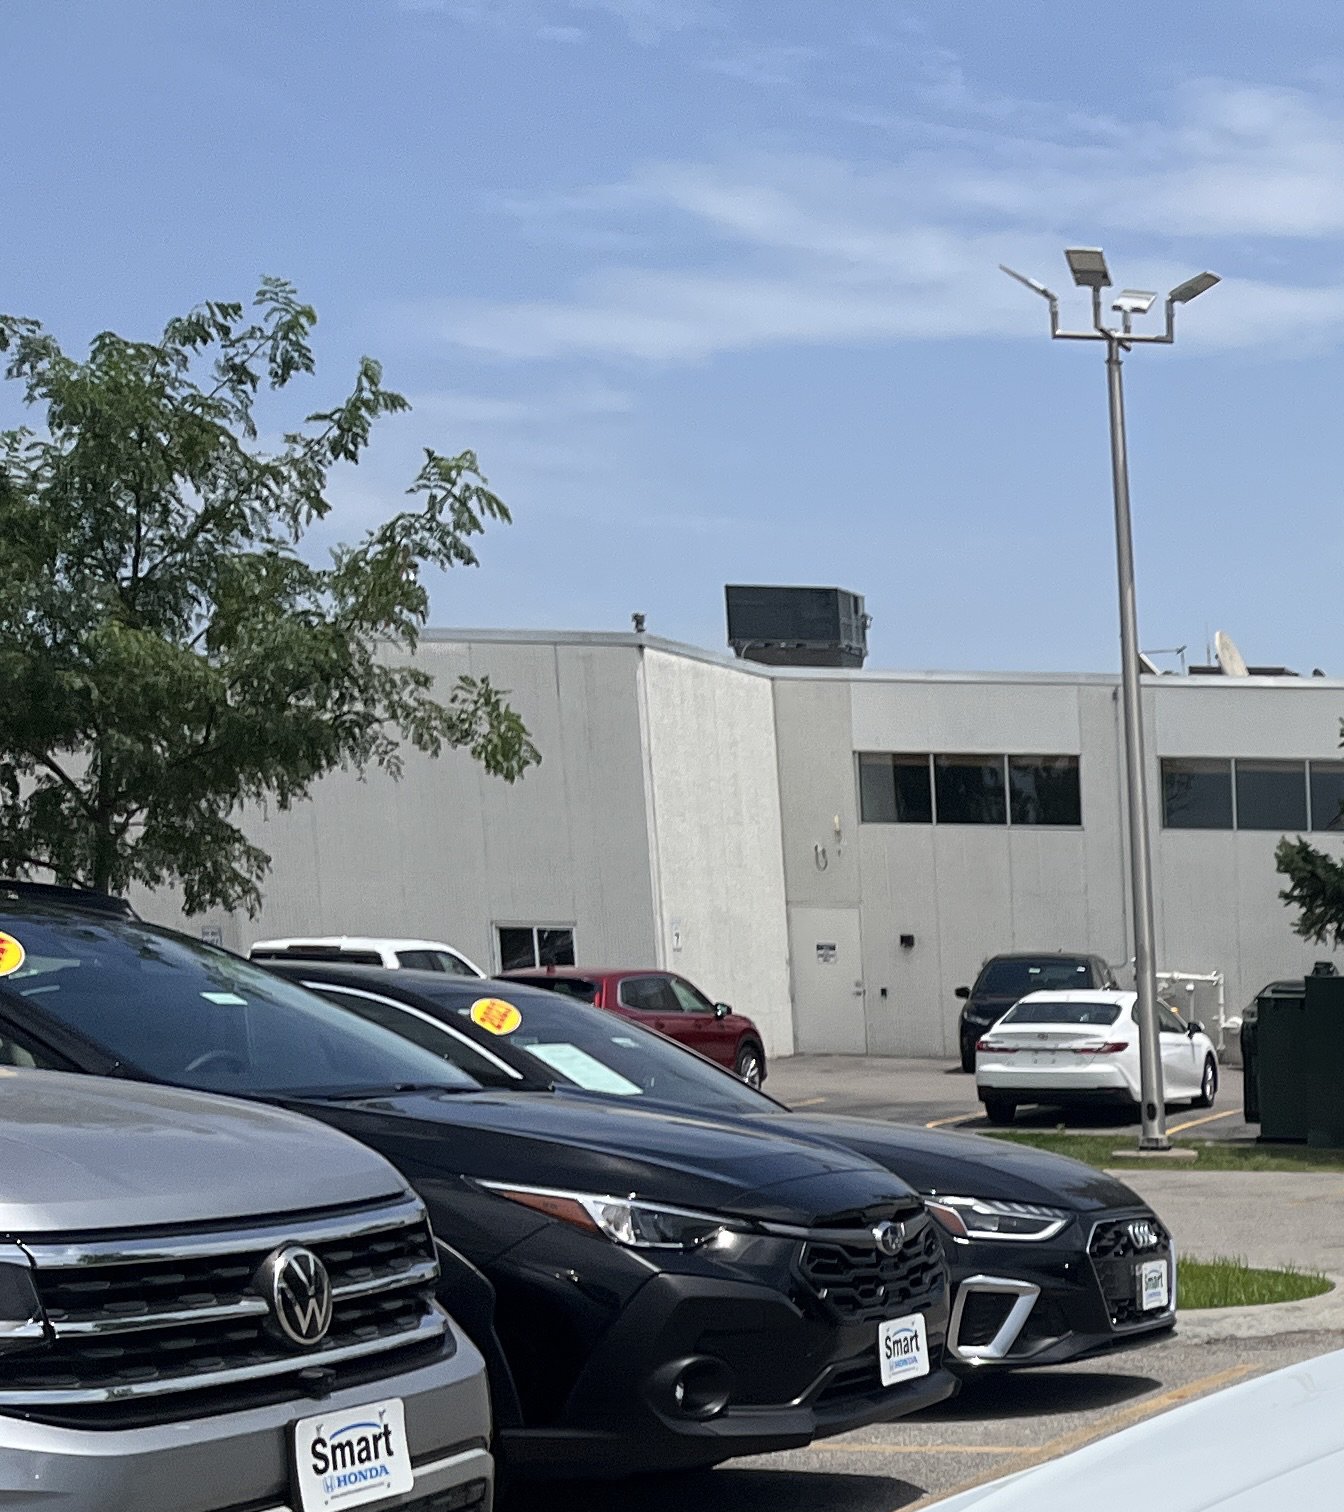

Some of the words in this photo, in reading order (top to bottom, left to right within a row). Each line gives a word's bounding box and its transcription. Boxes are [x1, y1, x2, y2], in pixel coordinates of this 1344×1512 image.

[885, 1329, 920, 1360] Smart
[311, 1423, 394, 1476] Smart
[336, 1465, 390, 1488] HONDA
